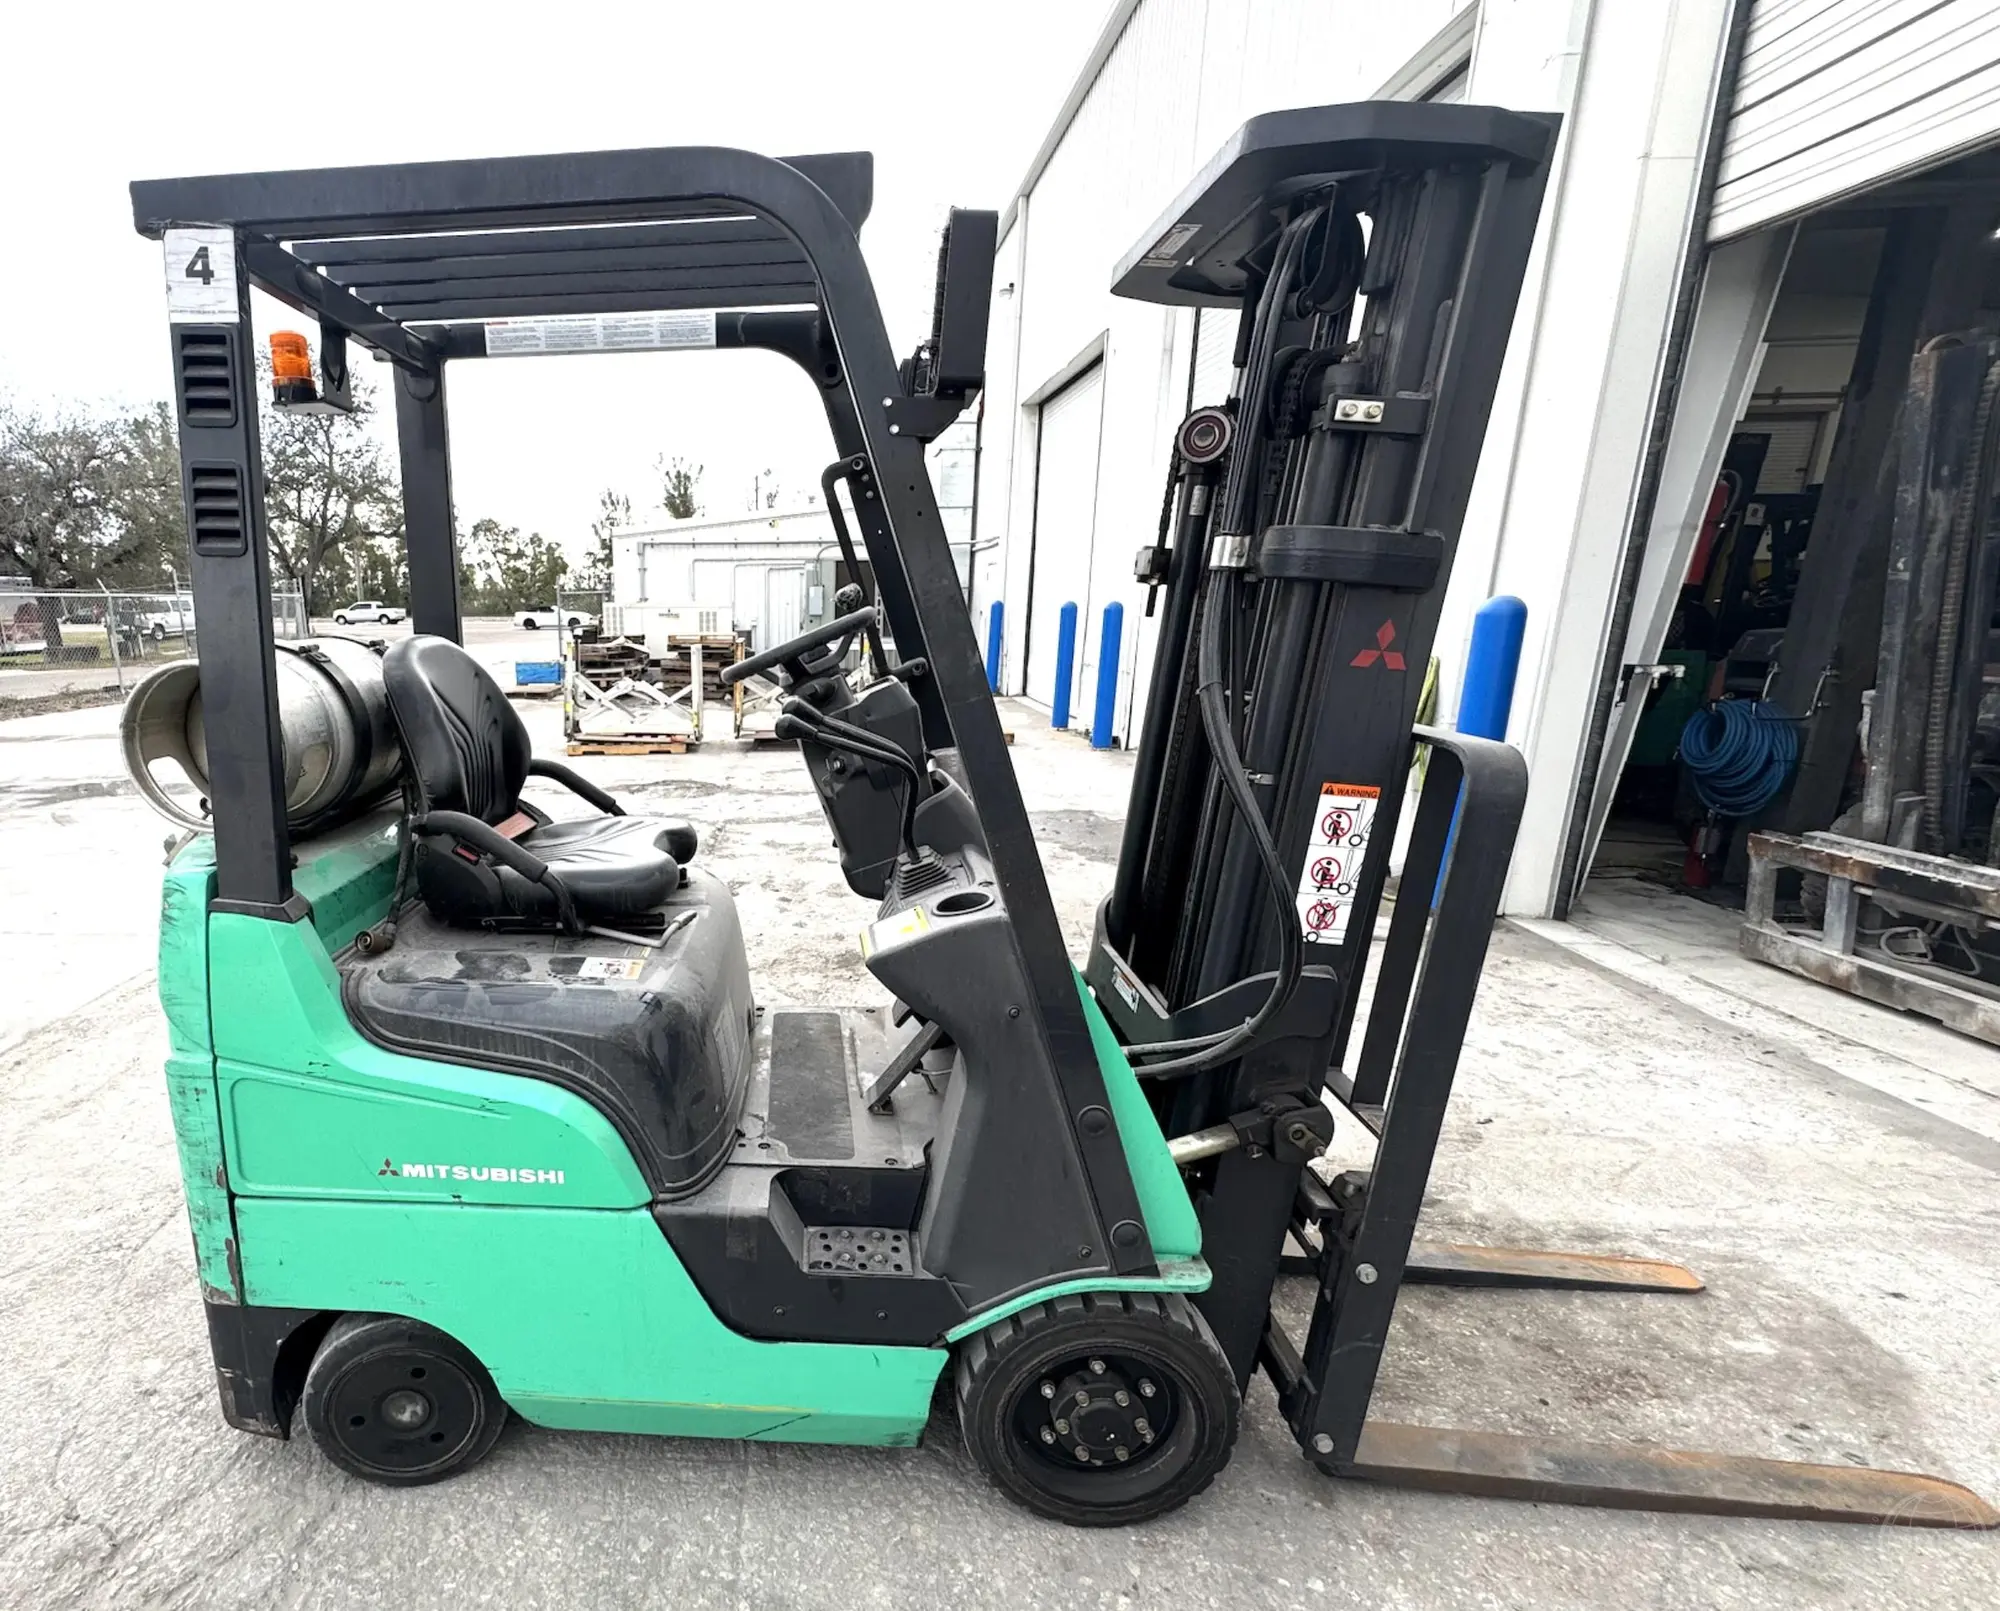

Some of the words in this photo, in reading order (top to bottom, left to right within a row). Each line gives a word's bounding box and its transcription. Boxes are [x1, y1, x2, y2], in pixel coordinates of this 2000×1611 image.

[185, 246, 215, 285] 4
[1337, 787, 1378, 799] WARNING
[402, 1163, 564, 1185] MITSUBISHI
